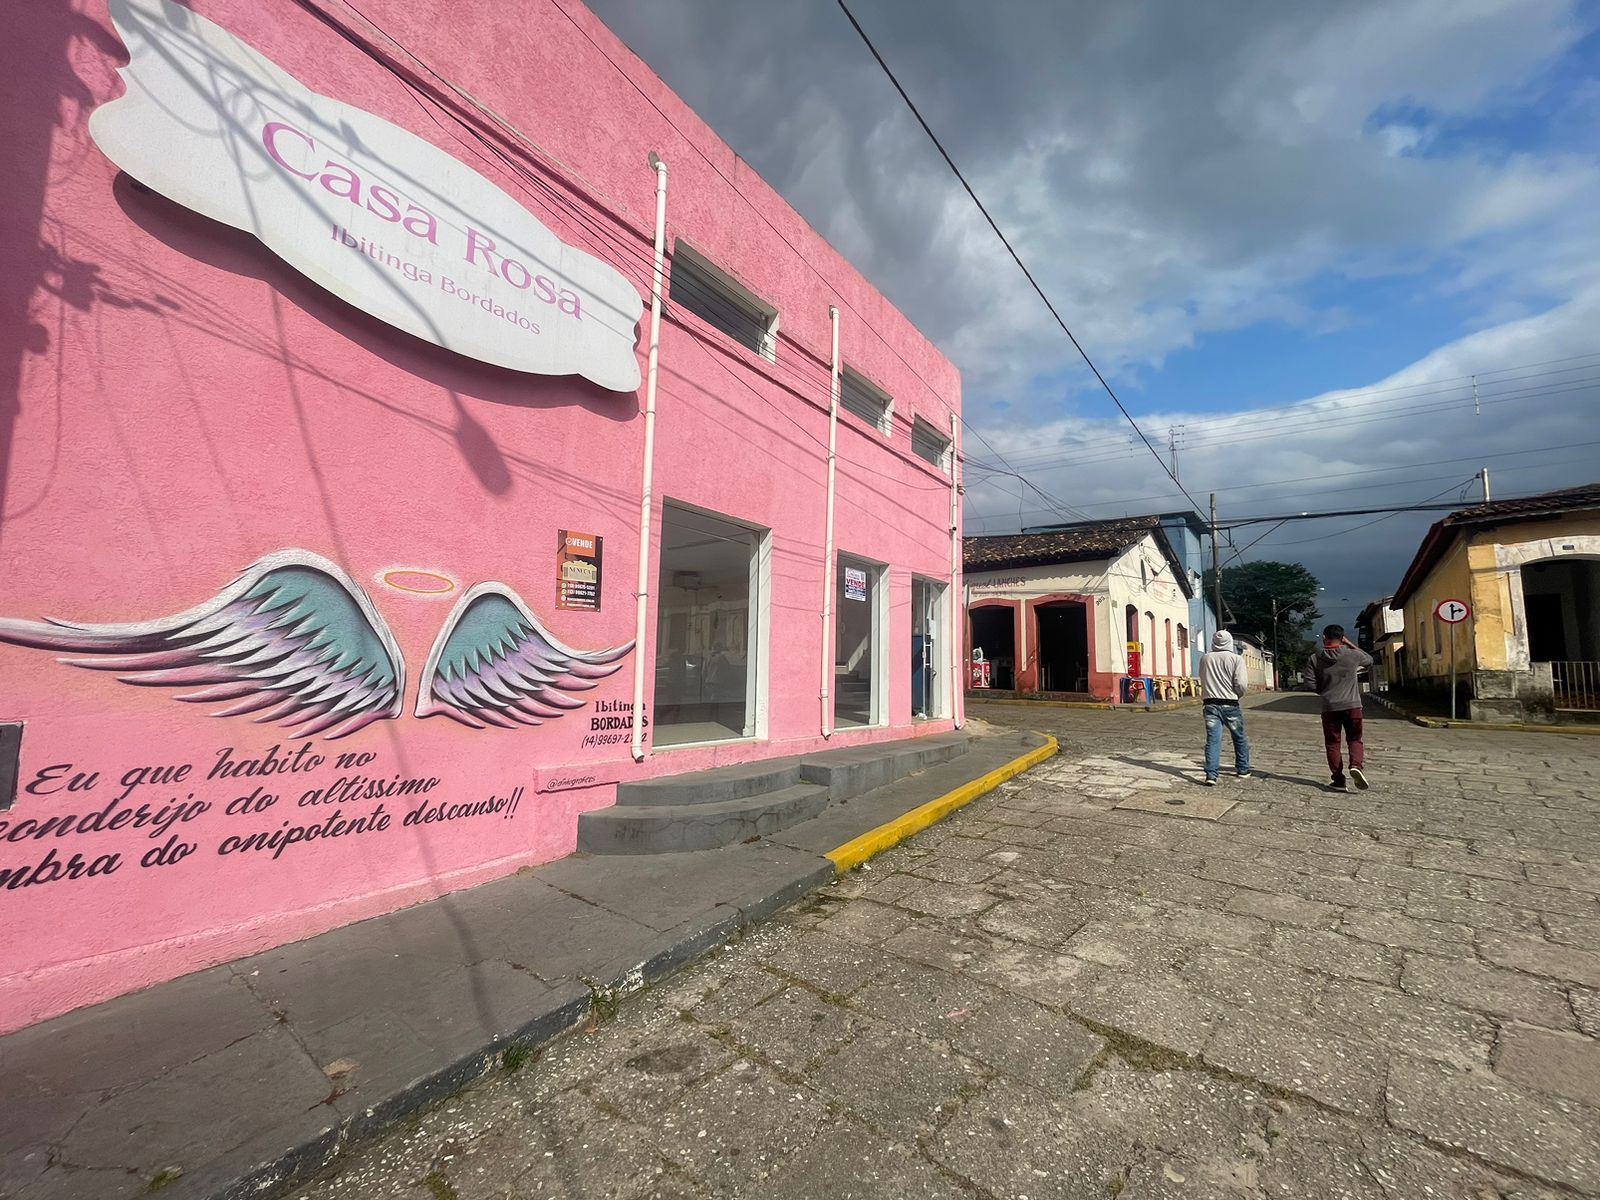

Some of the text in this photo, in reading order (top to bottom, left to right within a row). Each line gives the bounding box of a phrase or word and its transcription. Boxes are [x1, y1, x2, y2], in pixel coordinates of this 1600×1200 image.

[261, 120, 583, 321] Casa Rosa
[331, 222, 543, 336] Ibitinga Bordados
[572, 537, 593, 549] VENDE
[846, 578, 865, 589] VENDE
[590, 715, 649, 731] BORDADS
[581, 732, 648, 749] (14)99697-22
[25, 742, 377, 800] Eu que habito no
[225, 786, 280, 816] do
[140, 834, 198, 868] do
[217, 804, 391, 861] onipotente
[402, 786, 525, 827] descanso!!
